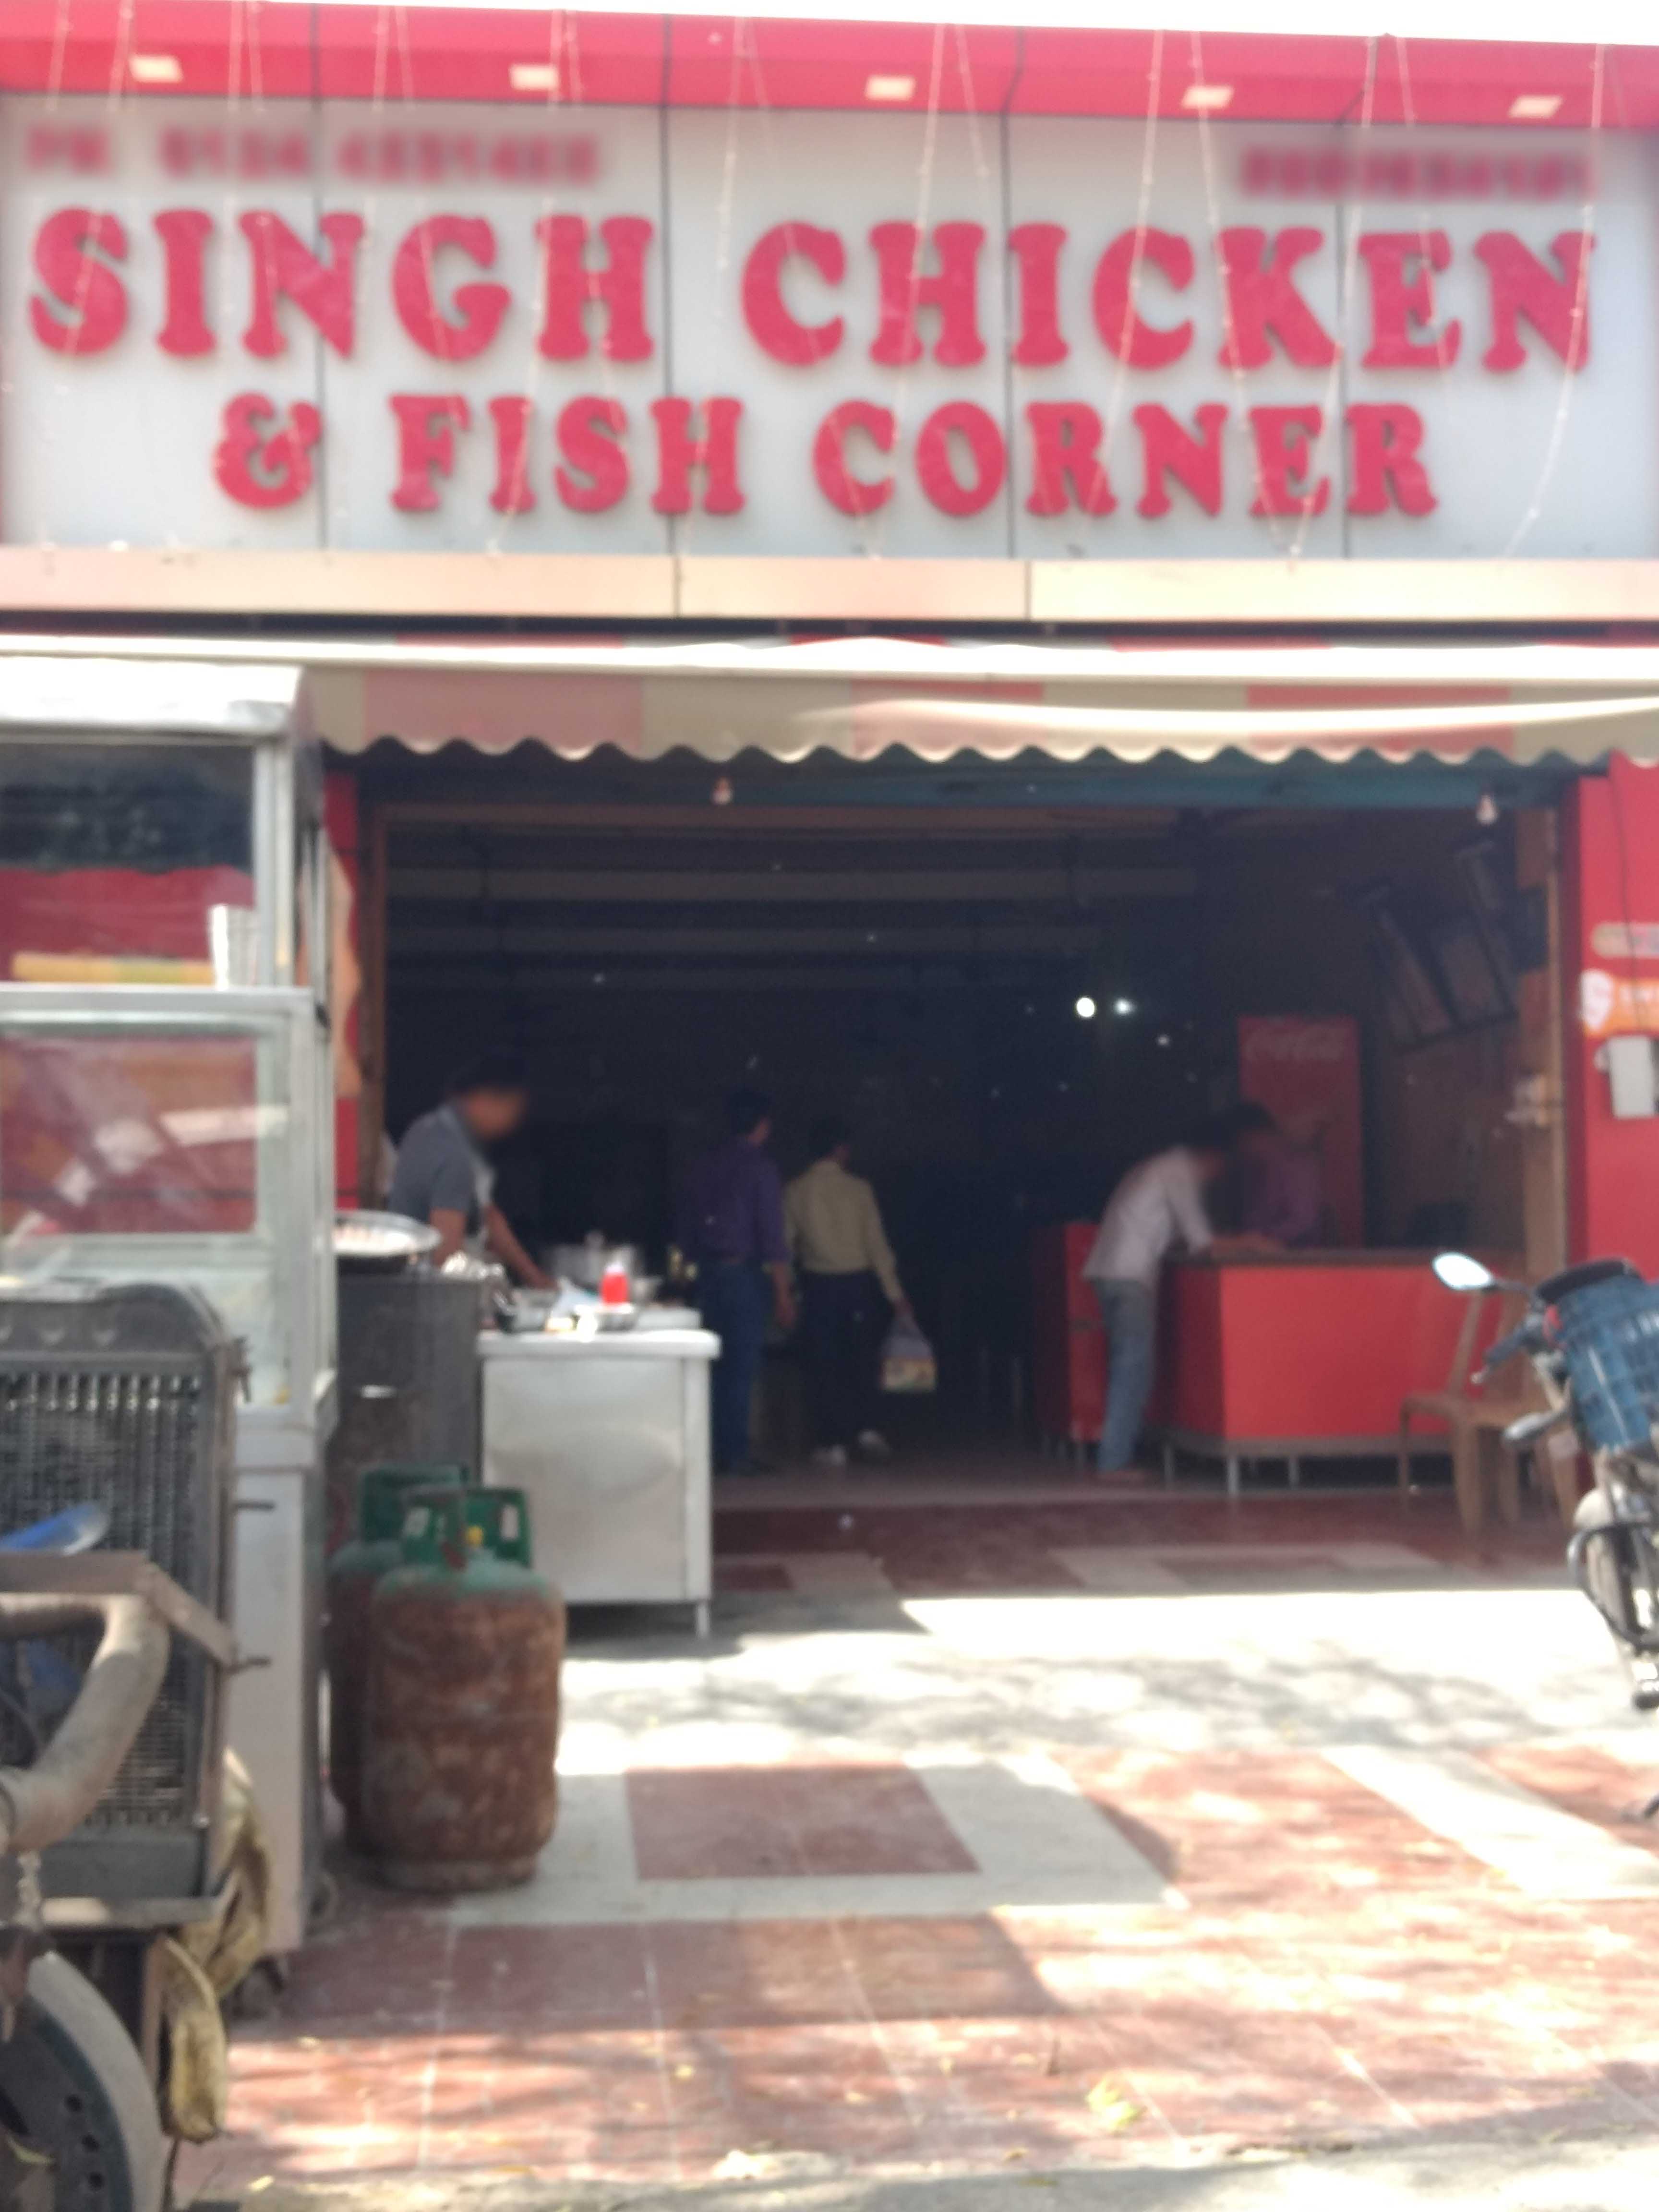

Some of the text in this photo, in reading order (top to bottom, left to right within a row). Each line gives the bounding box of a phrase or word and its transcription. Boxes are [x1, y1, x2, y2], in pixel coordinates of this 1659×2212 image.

[29, 207, 1597, 373] SINGH CHICKEN
[214, 394, 1437, 519] & FISH CORNER
